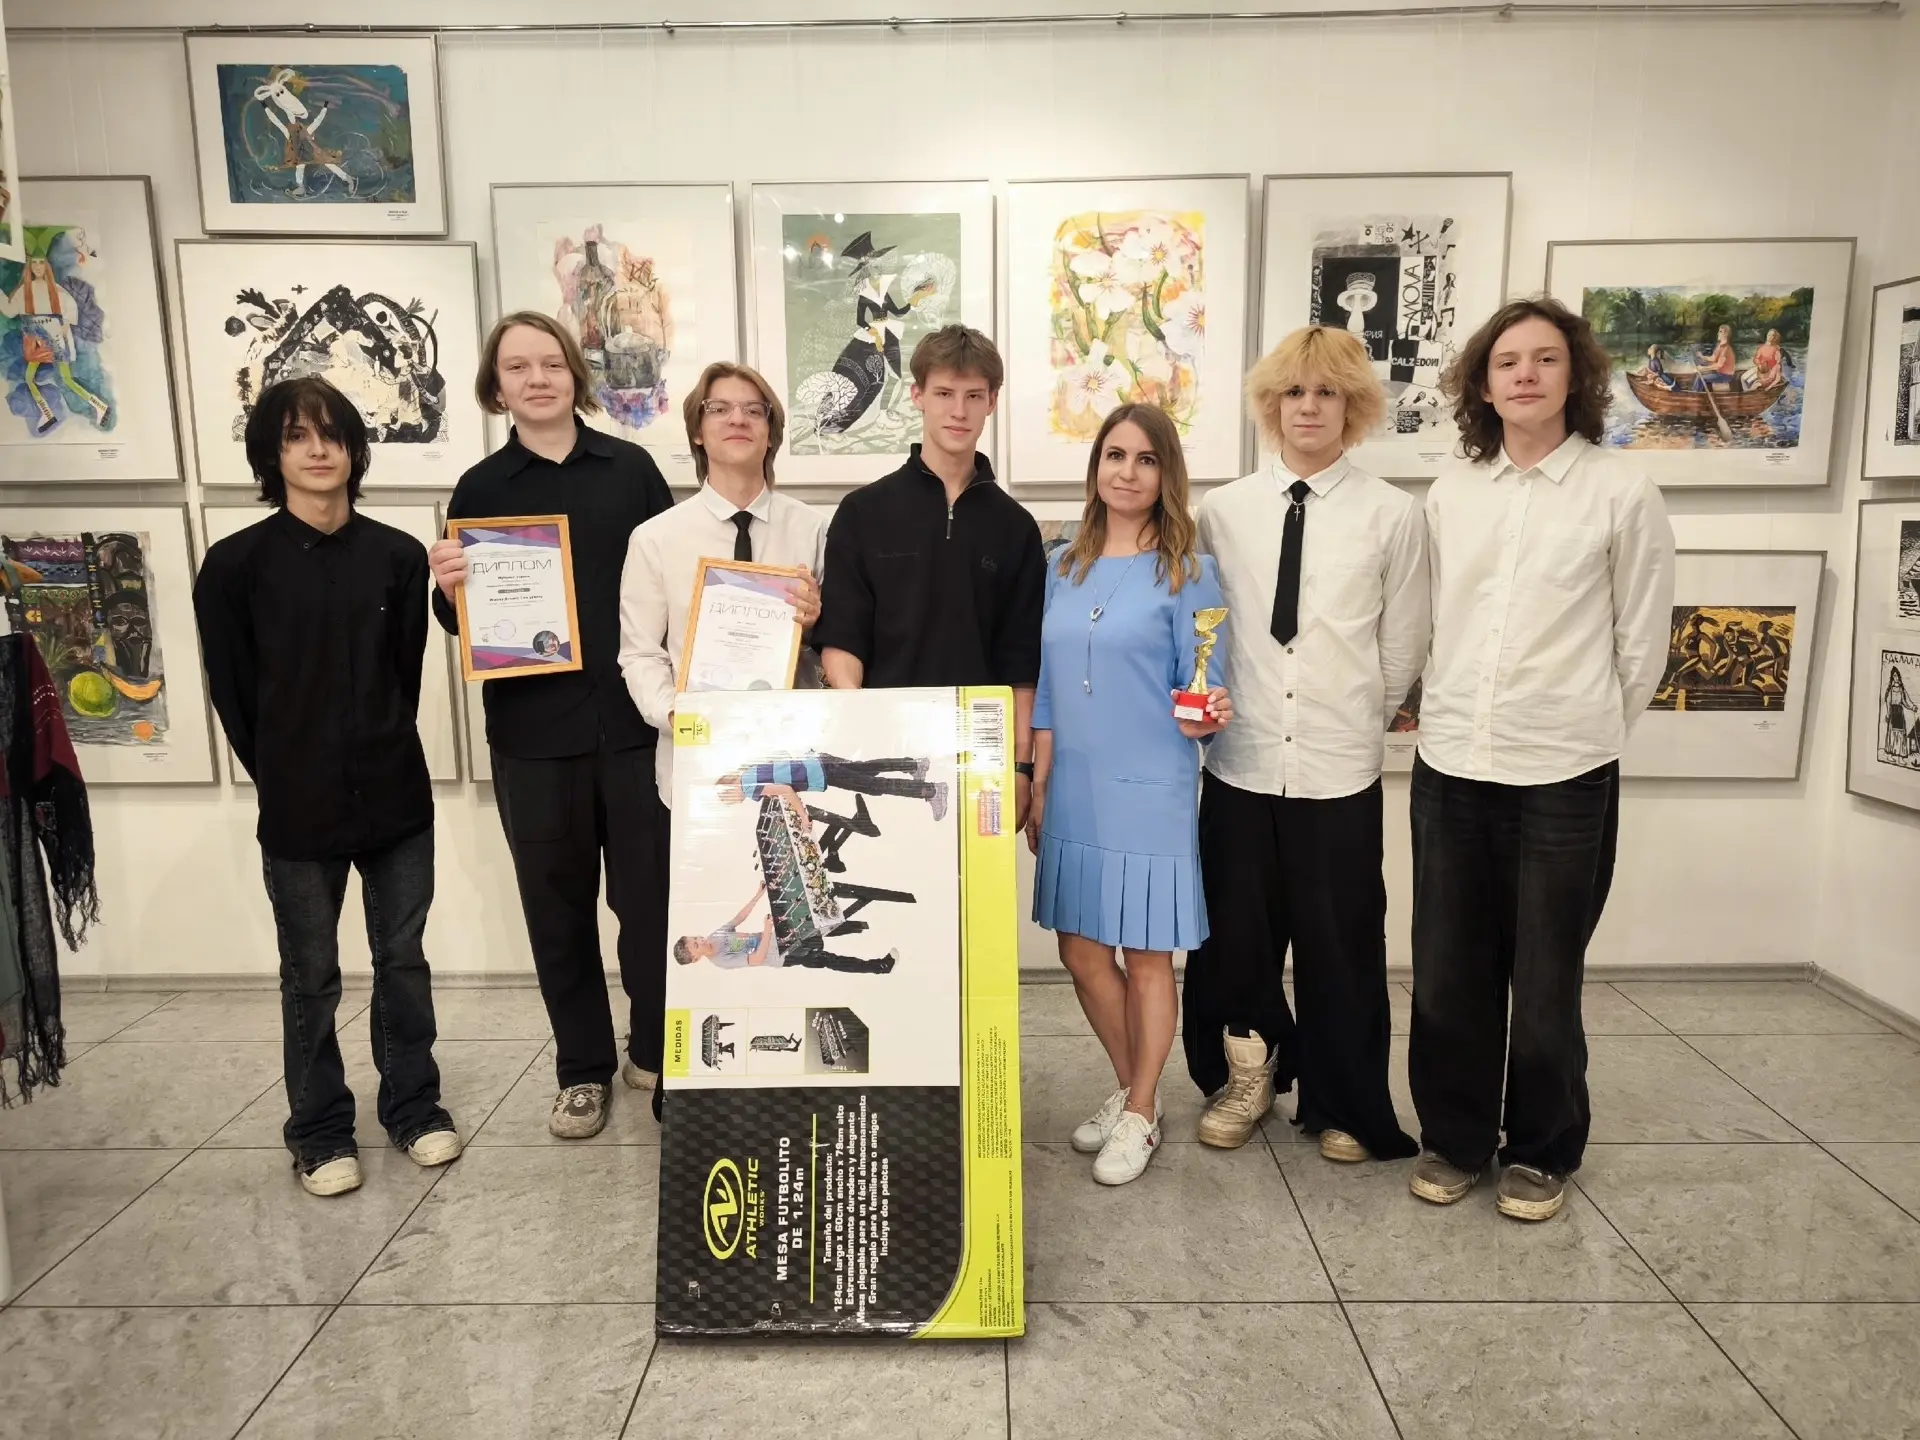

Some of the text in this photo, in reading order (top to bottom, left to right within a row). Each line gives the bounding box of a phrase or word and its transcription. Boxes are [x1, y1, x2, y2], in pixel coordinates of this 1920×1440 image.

[472, 558, 552, 575] ДИПЛОМ
[709, 601, 788, 621] ДИПЛОМ
[674, 1019, 683, 1063] MEDIDAS
[836, 1105, 844, 1124] alto
[869, 1113, 879, 1148] amigos
[847, 1112, 857, 1154] elegante
[858, 1096, 866, 1176] almacenamiento
[836, 1169, 844, 1198] ancho
[846, 1167, 855, 1213] duradero
[858, 1180, 866, 1200] fácil
[869, 1162, 878, 1210] familiares
[881, 1158, 890, 1195] pelotas
[746, 1158, 758, 1258] ATHLETIC
[777, 1137, 790, 1280] MESA FUTBOLITO
[793, 1168, 804, 1248] DE 1.24m
[823, 1153, 834, 1263] Tamaño del producto:
[836, 1202, 844, 1232] 60cm
[860, 1204, 866, 1216] un
[860, 1221, 868, 1243] para
[871, 1215, 879, 1238] para
[881, 1221, 890, 1256] Incluye
[835, 1245, 845, 1271] largo
[846, 1216, 854, 1304] Extremadamente
[858, 1247, 868, 1289] plegable
[869, 1242, 879, 1274] regalo
[835, 1275, 843, 1312] 124cm
